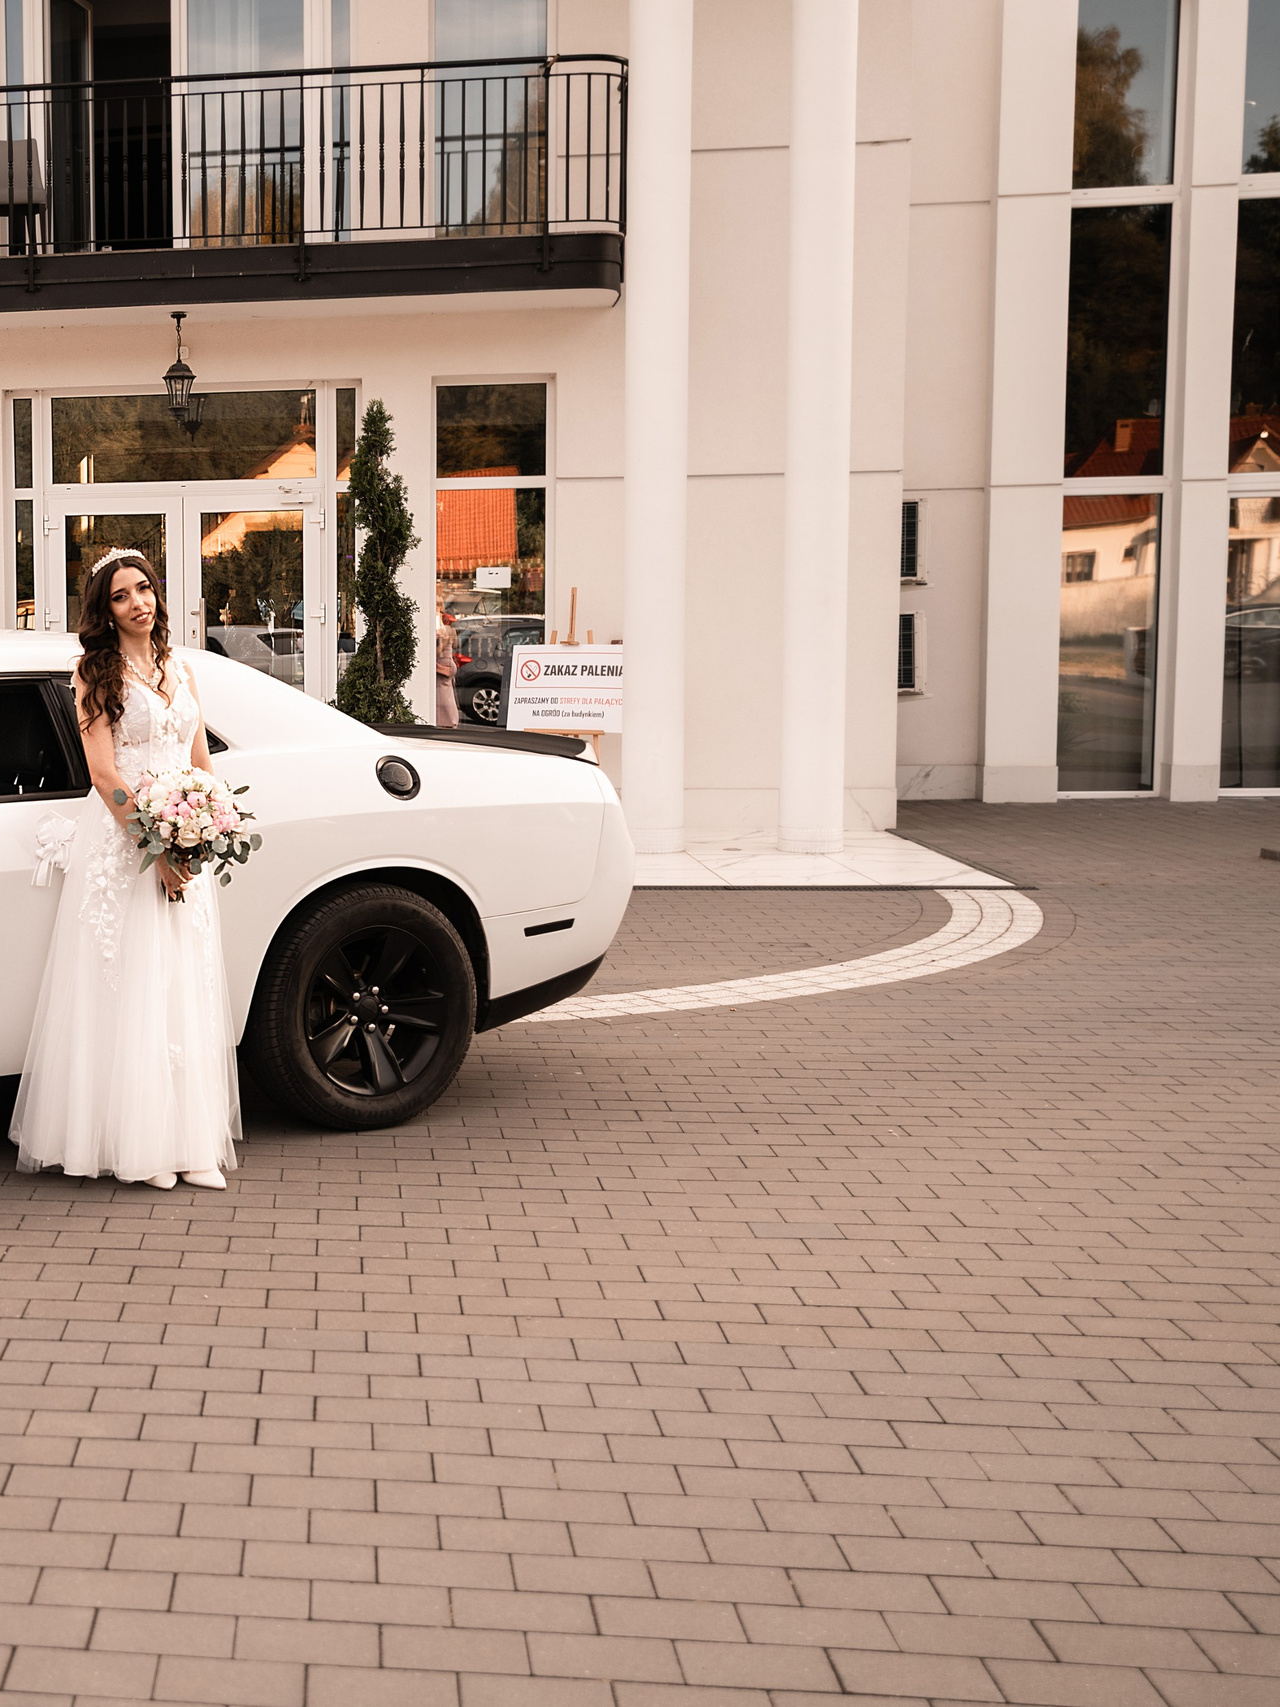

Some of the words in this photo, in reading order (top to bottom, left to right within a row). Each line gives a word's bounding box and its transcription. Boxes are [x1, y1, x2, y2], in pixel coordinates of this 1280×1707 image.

[543, 664, 578, 676] ZAKAZ
[514, 697, 549, 705] ZAPRASZAMY
[550, 697, 558, 705] DO
[559, 697, 580, 705] STREFY
[541, 709, 560, 717] OGRÓD
[561, 710, 571, 718] (za
[571, 711, 605, 719] budynkiem)
